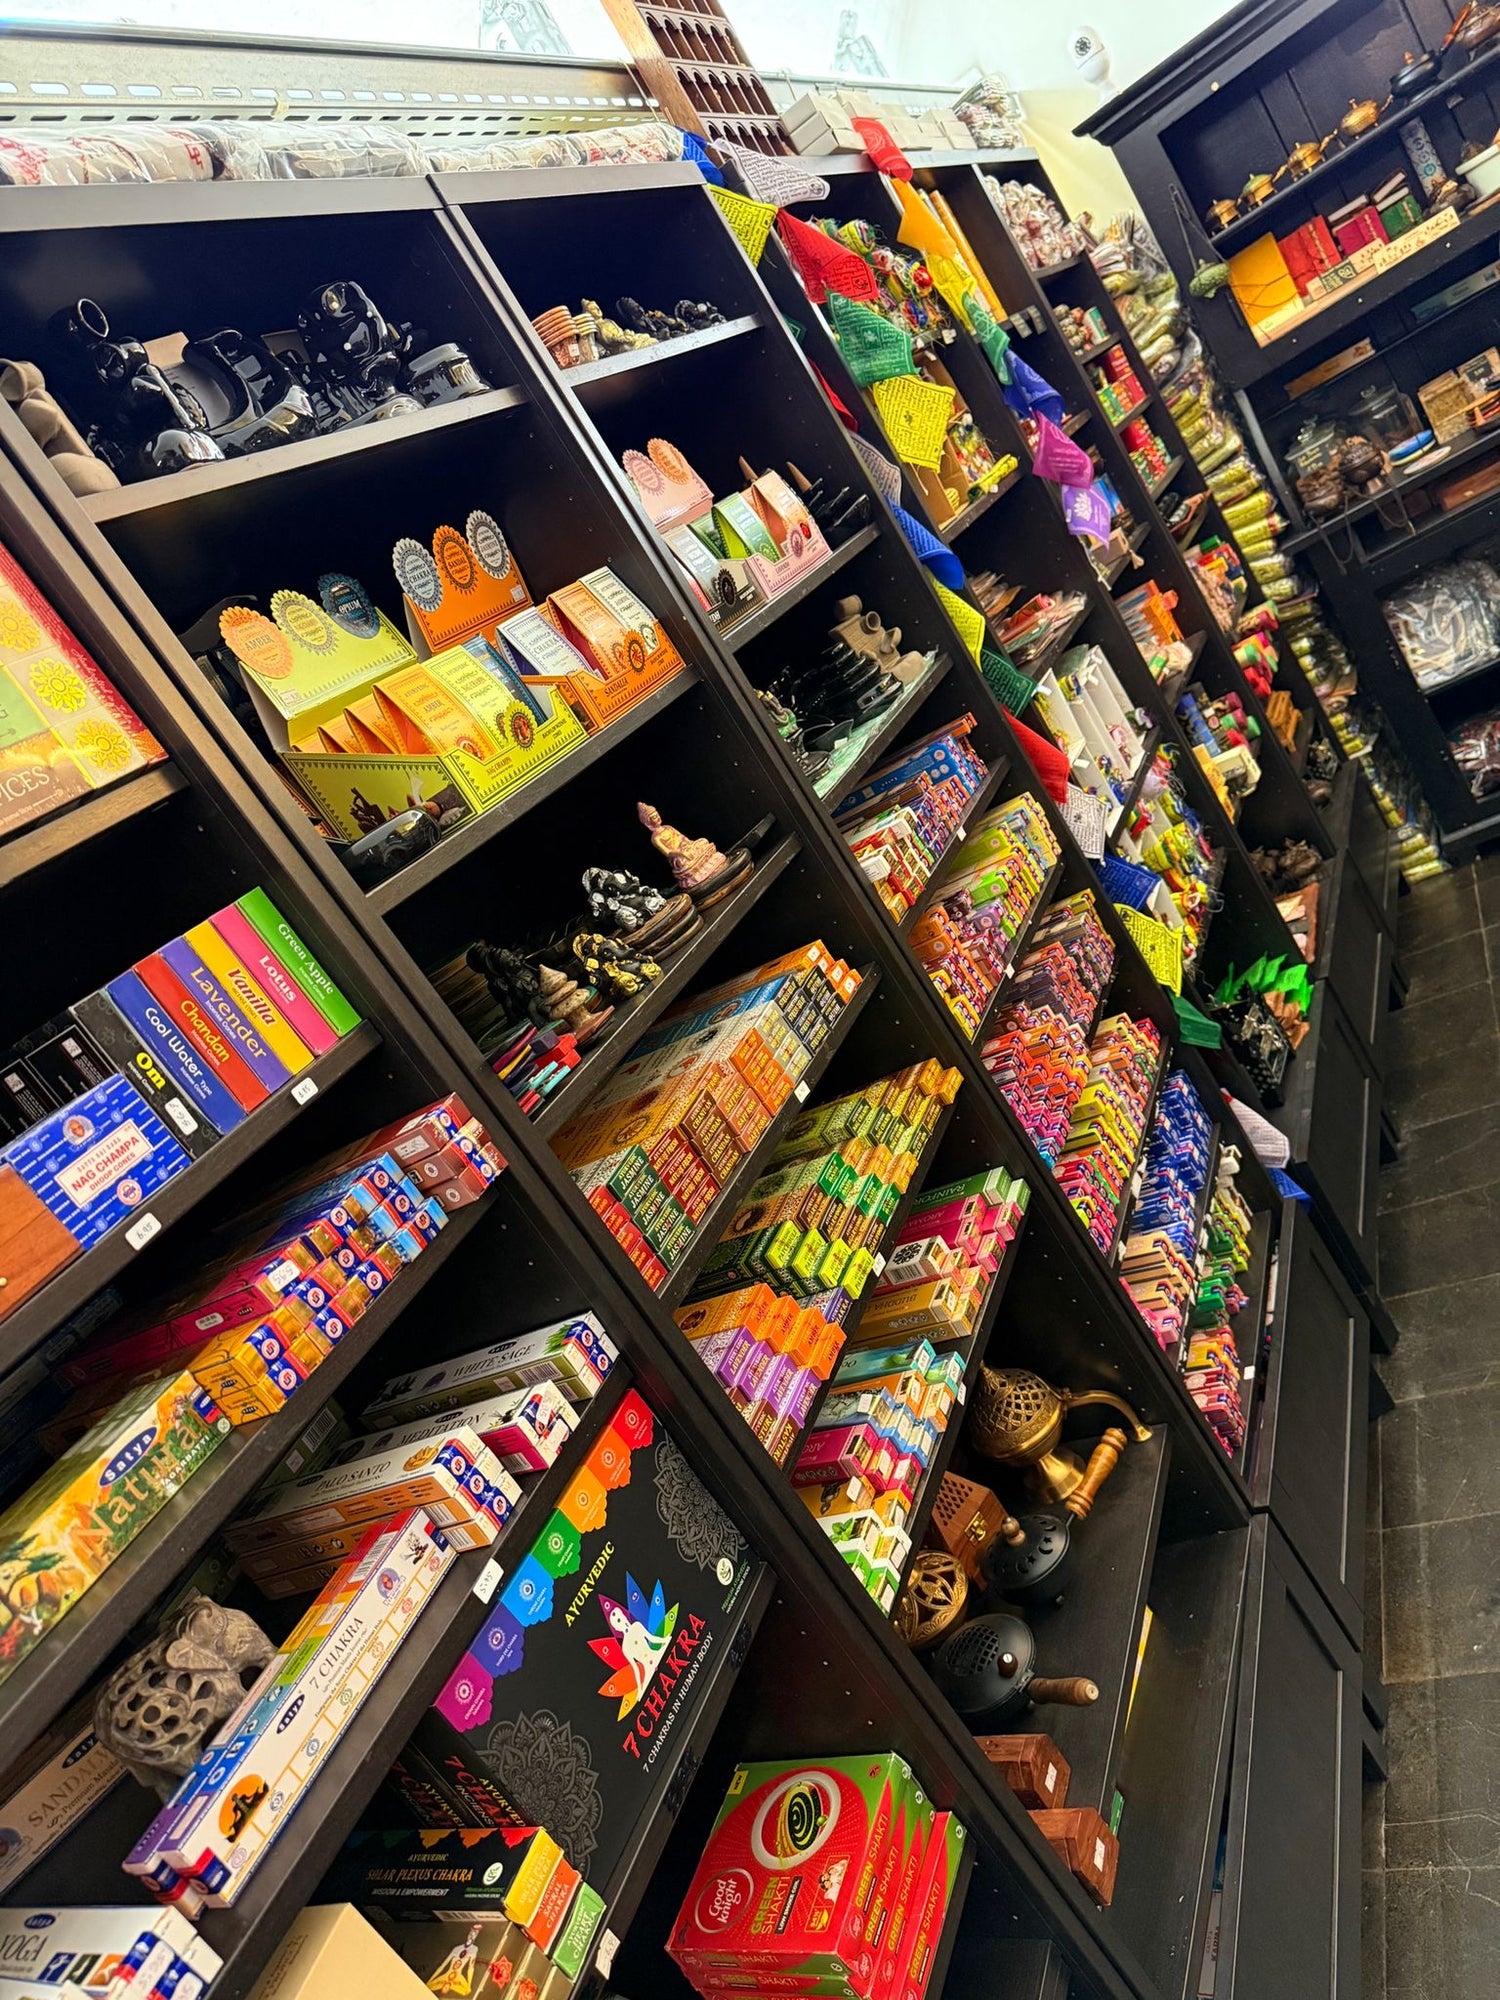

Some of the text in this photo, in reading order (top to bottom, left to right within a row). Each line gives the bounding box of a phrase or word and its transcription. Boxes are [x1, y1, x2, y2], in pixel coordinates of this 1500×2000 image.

[0, 766, 50, 805] ICES
[278, 924, 334, 994] Green Apple
[259, 955, 296, 1002] Lotus
[191, 966, 266, 1058] Lavender
[228, 969, 277, 1025] Vanilla
[145, 1008, 203, 1077] Cool Water
[181, 1000, 230, 1063] Chandan
[136, 1052, 166, 1090] Om
[692, 1100, 713, 1130] CHANDAN
[724, 1084, 745, 1113] SAFFRON
[737, 1099, 757, 1126] SAFFRON
[701, 1116, 722, 1147] CHANDAN
[749, 1114, 768, 1145] SAFFRON
[71, 1136, 140, 1191] NAG CHAMPA
[711, 1133, 731, 1163] CHANDAN
[720, 1149, 740, 1180] CHANDAN
[90, 1152, 136, 1191] DHOOP CONES
[621, 1156, 644, 1190] JASMINE
[631, 1174, 655, 1209] JASMINE
[642, 1191, 666, 1226] JASMINE
[656, 1208, 679, 1242] JASMINE
[666, 1223, 685, 1250] AYURVEDIC
[669, 1226, 692, 1261] JASMINE
[778, 1230, 797, 1262] PATCHOULI
[805, 1238, 823, 1274] PATCHOULI
[832, 1249, 849, 1284] PATCHOULI
[855, 1256, 873, 1291] PATCHOULI
[756, 1302, 769, 1322] AMBER
[873, 1292, 918, 1312] BUDDHA
[781, 1312, 794, 1333] AMBER
[808, 1324, 820, 1346] AMBER
[453, 1343, 536, 1378] WHITE SAGE
[730, 1340, 751, 1375] LAVENDER
[828, 1340, 840, 1362] AMBER
[750, 1355, 771, 1389] LAVENDER
[774, 1369, 794, 1404] LAVENDER
[798, 1383, 818, 1418] LAVENDER
[400, 1413, 485, 1446] MEDITATION
[754, 1414, 775, 1441] STURI
[773, 1423, 794, 1463] KASTURI
[105, 1434, 152, 1482] Satya
[163, 1434, 210, 1487] AGARBATTI
[315, 1461, 392, 1491] PALO SANTO
[564, 1541, 615, 1627] AYURVEDIC
[309, 1616, 364, 1690] 7 CHAKRA
[622, 1613, 707, 1759] 7 CHAKRA
[642, 1632, 714, 1773] 7 CHAKRAS IN HUMAN BODY
[65, 1733, 99, 1765] Saty
[445, 1755, 465, 1769] 7
[61, 1781, 95, 1814] Premium
[733, 1773, 743, 1790] NEW
[455, 1784, 496, 1826] INCIENS
[479, 1777, 527, 1827] AYURVED
[407, 1853, 450, 1862] AYURVEDIC
[856, 1814, 888, 1908] GREEN SHAKTI
[395, 1869, 434, 1883] PLEXUS
[433, 1868, 474, 1881] CHAKRA
[401, 1888, 450, 1896] EMPOWERMENT
[541, 1881, 564, 1916] SACRAL
[543, 1883, 571, 1927] CHAKRA
[709, 1878, 727, 1917] Good
[717, 1877, 742, 1924] knight
[751, 1877, 779, 1935] GREEN
[762, 1875, 791, 1935] SHAKTI
[865, 1847, 899, 1942] GREEN SHAKTI
[888, 1855, 918, 1951] GREEN SHAKTI
[561, 1902, 590, 1946] AYURVEDIC
[569, 1909, 601, 1959] CHAKRA
[778, 1912, 786, 1931] LOW
[910, 1881, 941, 1978] GREEN SHAKTI
